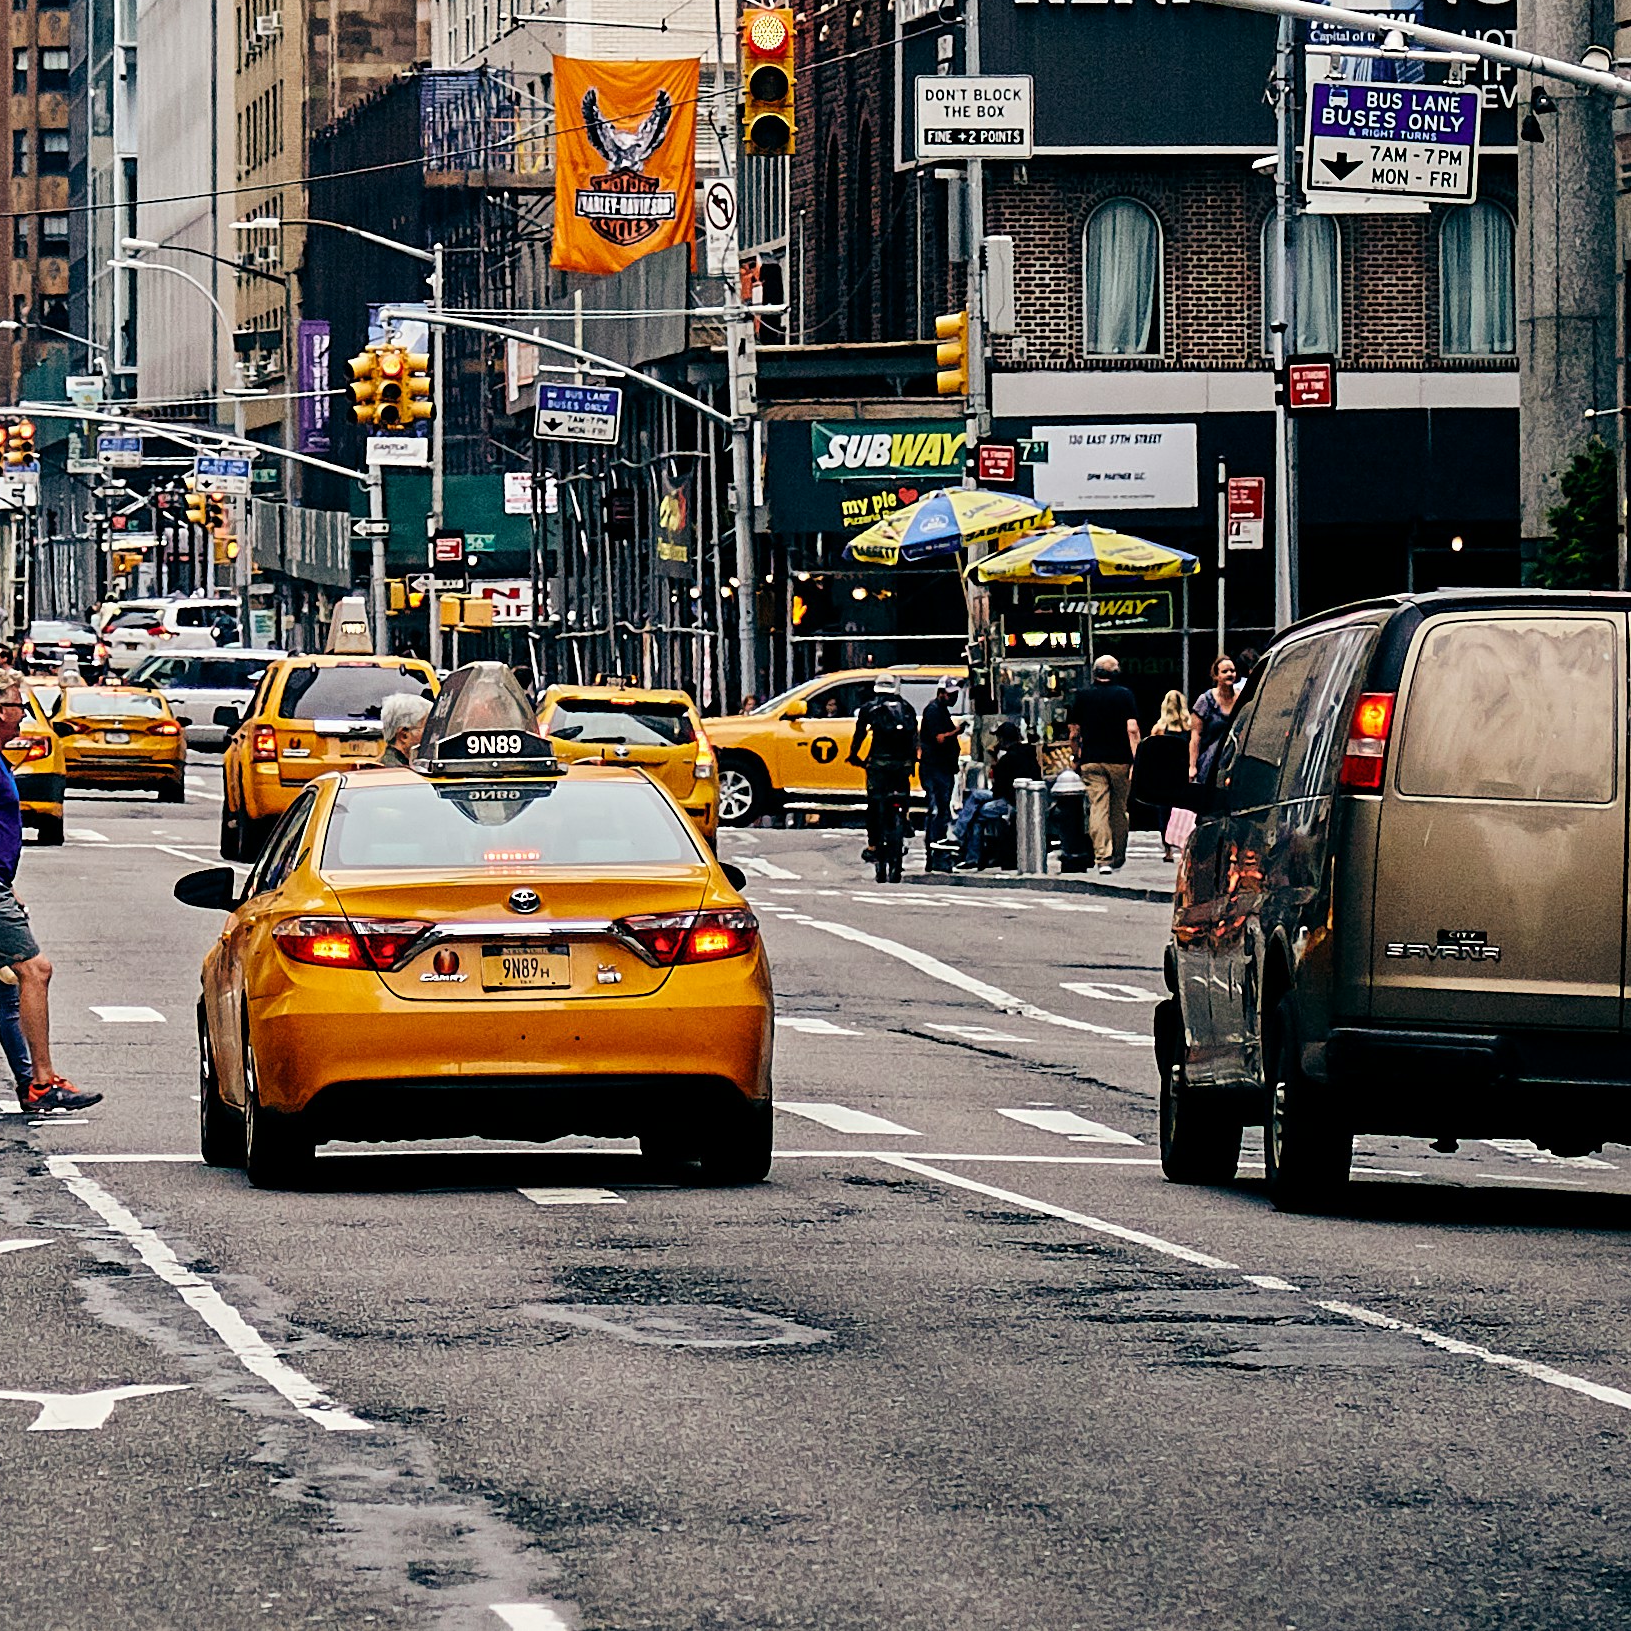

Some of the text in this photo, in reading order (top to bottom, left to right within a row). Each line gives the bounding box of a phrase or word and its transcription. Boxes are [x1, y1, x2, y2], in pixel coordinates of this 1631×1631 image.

[1310, 30, 1349, 44] Capital
[1352, 31, 1364, 42] of
[925, 89, 1022, 101] DON'T BLOCK
[1366, 91, 1461, 114] BUS LANE
[943, 105, 1005, 118] THE BOX
[1321, 108, 1465, 133] BUSES ONLY
[927, 130, 953, 143] FINE
[980, 130, 1021, 143] POINTS
[1348, 127, 1437, 142] & RIGHT TURNS
[1370, 145, 1407, 163] 7AM
[1371, 168, 1409, 186] MON
[1429, 171, 1458, 188] FRI
[599, 219, 651, 241] CYCLES
[547, 399, 609, 412] BUSES ONLY
[1086, 434, 1107, 445] EAST
[1109, 434, 1131, 445] 57TH
[1134, 433, 1163, 444] STREET
[817, 432, 967, 470] SUBWAY
[841, 497, 869, 516] my
[871, 490, 897, 514] pie
[466, 735, 522, 755] 9N89
[815, 740, 833, 761] T
[1448, 931, 1476, 939] CITY
[1386, 943, 1501, 961] SAVANA
[419, 973, 469, 983] CAMRY
